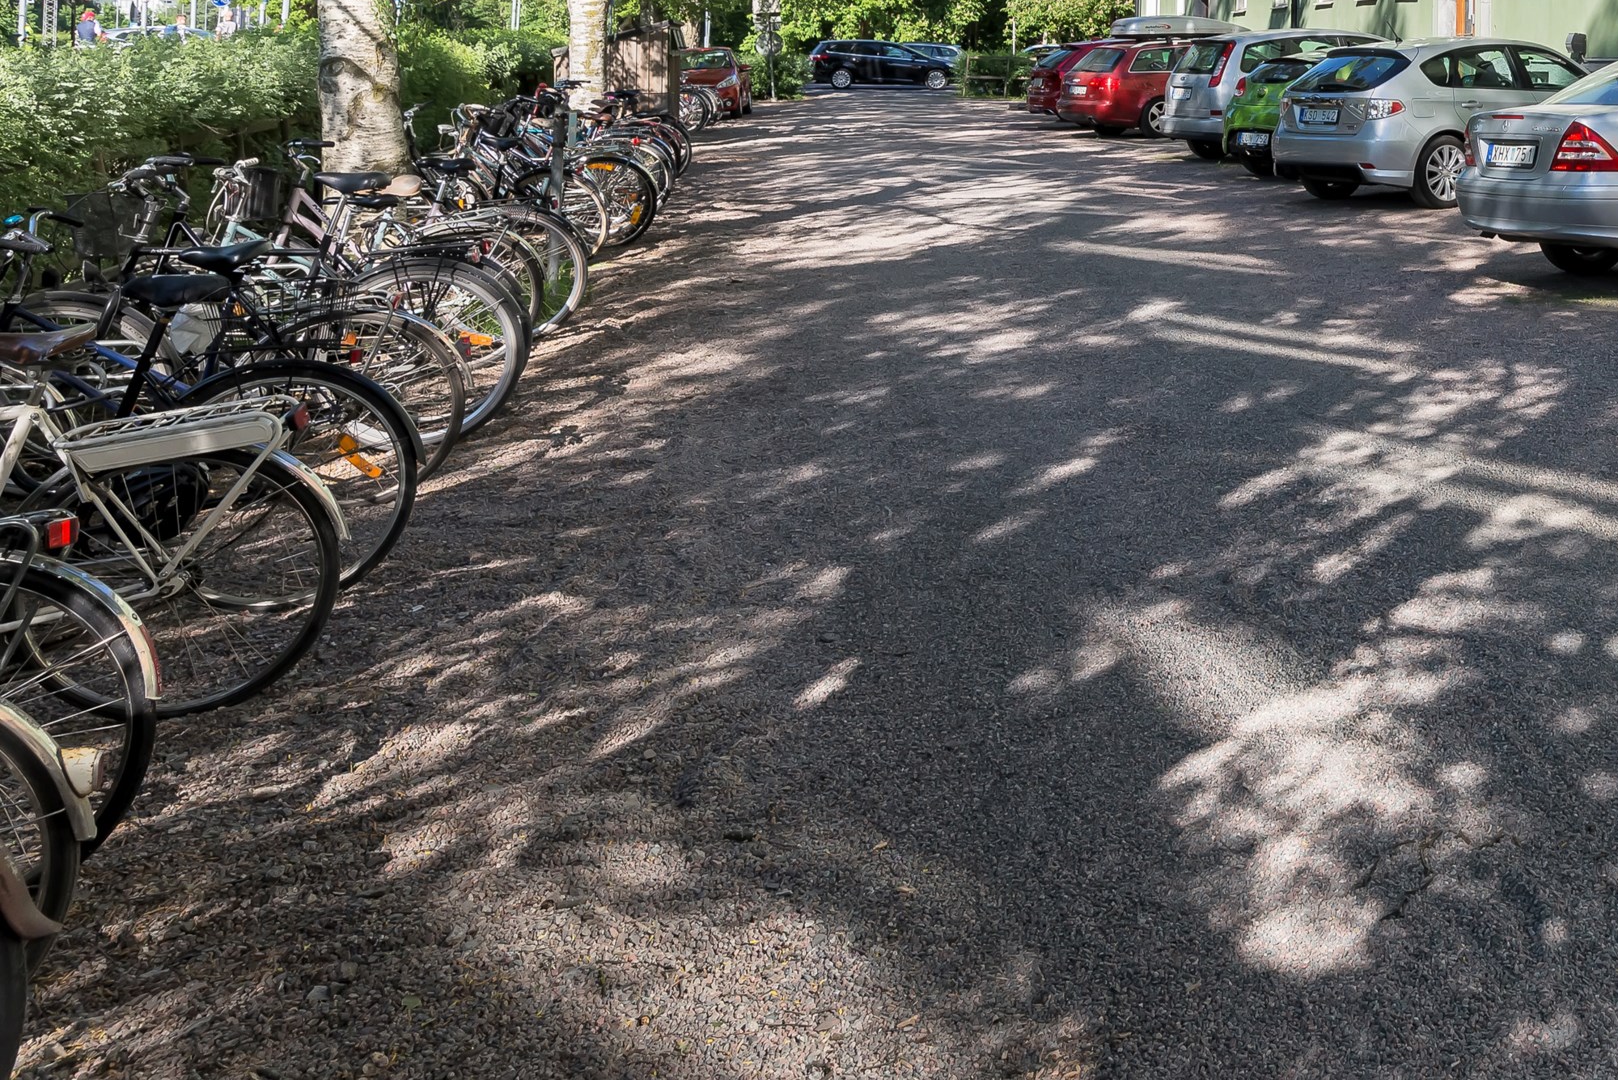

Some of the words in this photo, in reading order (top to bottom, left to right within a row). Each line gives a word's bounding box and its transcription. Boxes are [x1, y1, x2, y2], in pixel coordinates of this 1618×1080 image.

[1321, 110, 1337, 121] 542
[1492, 145, 1511, 161] XHX
[1514, 147, 1534, 163] 751
